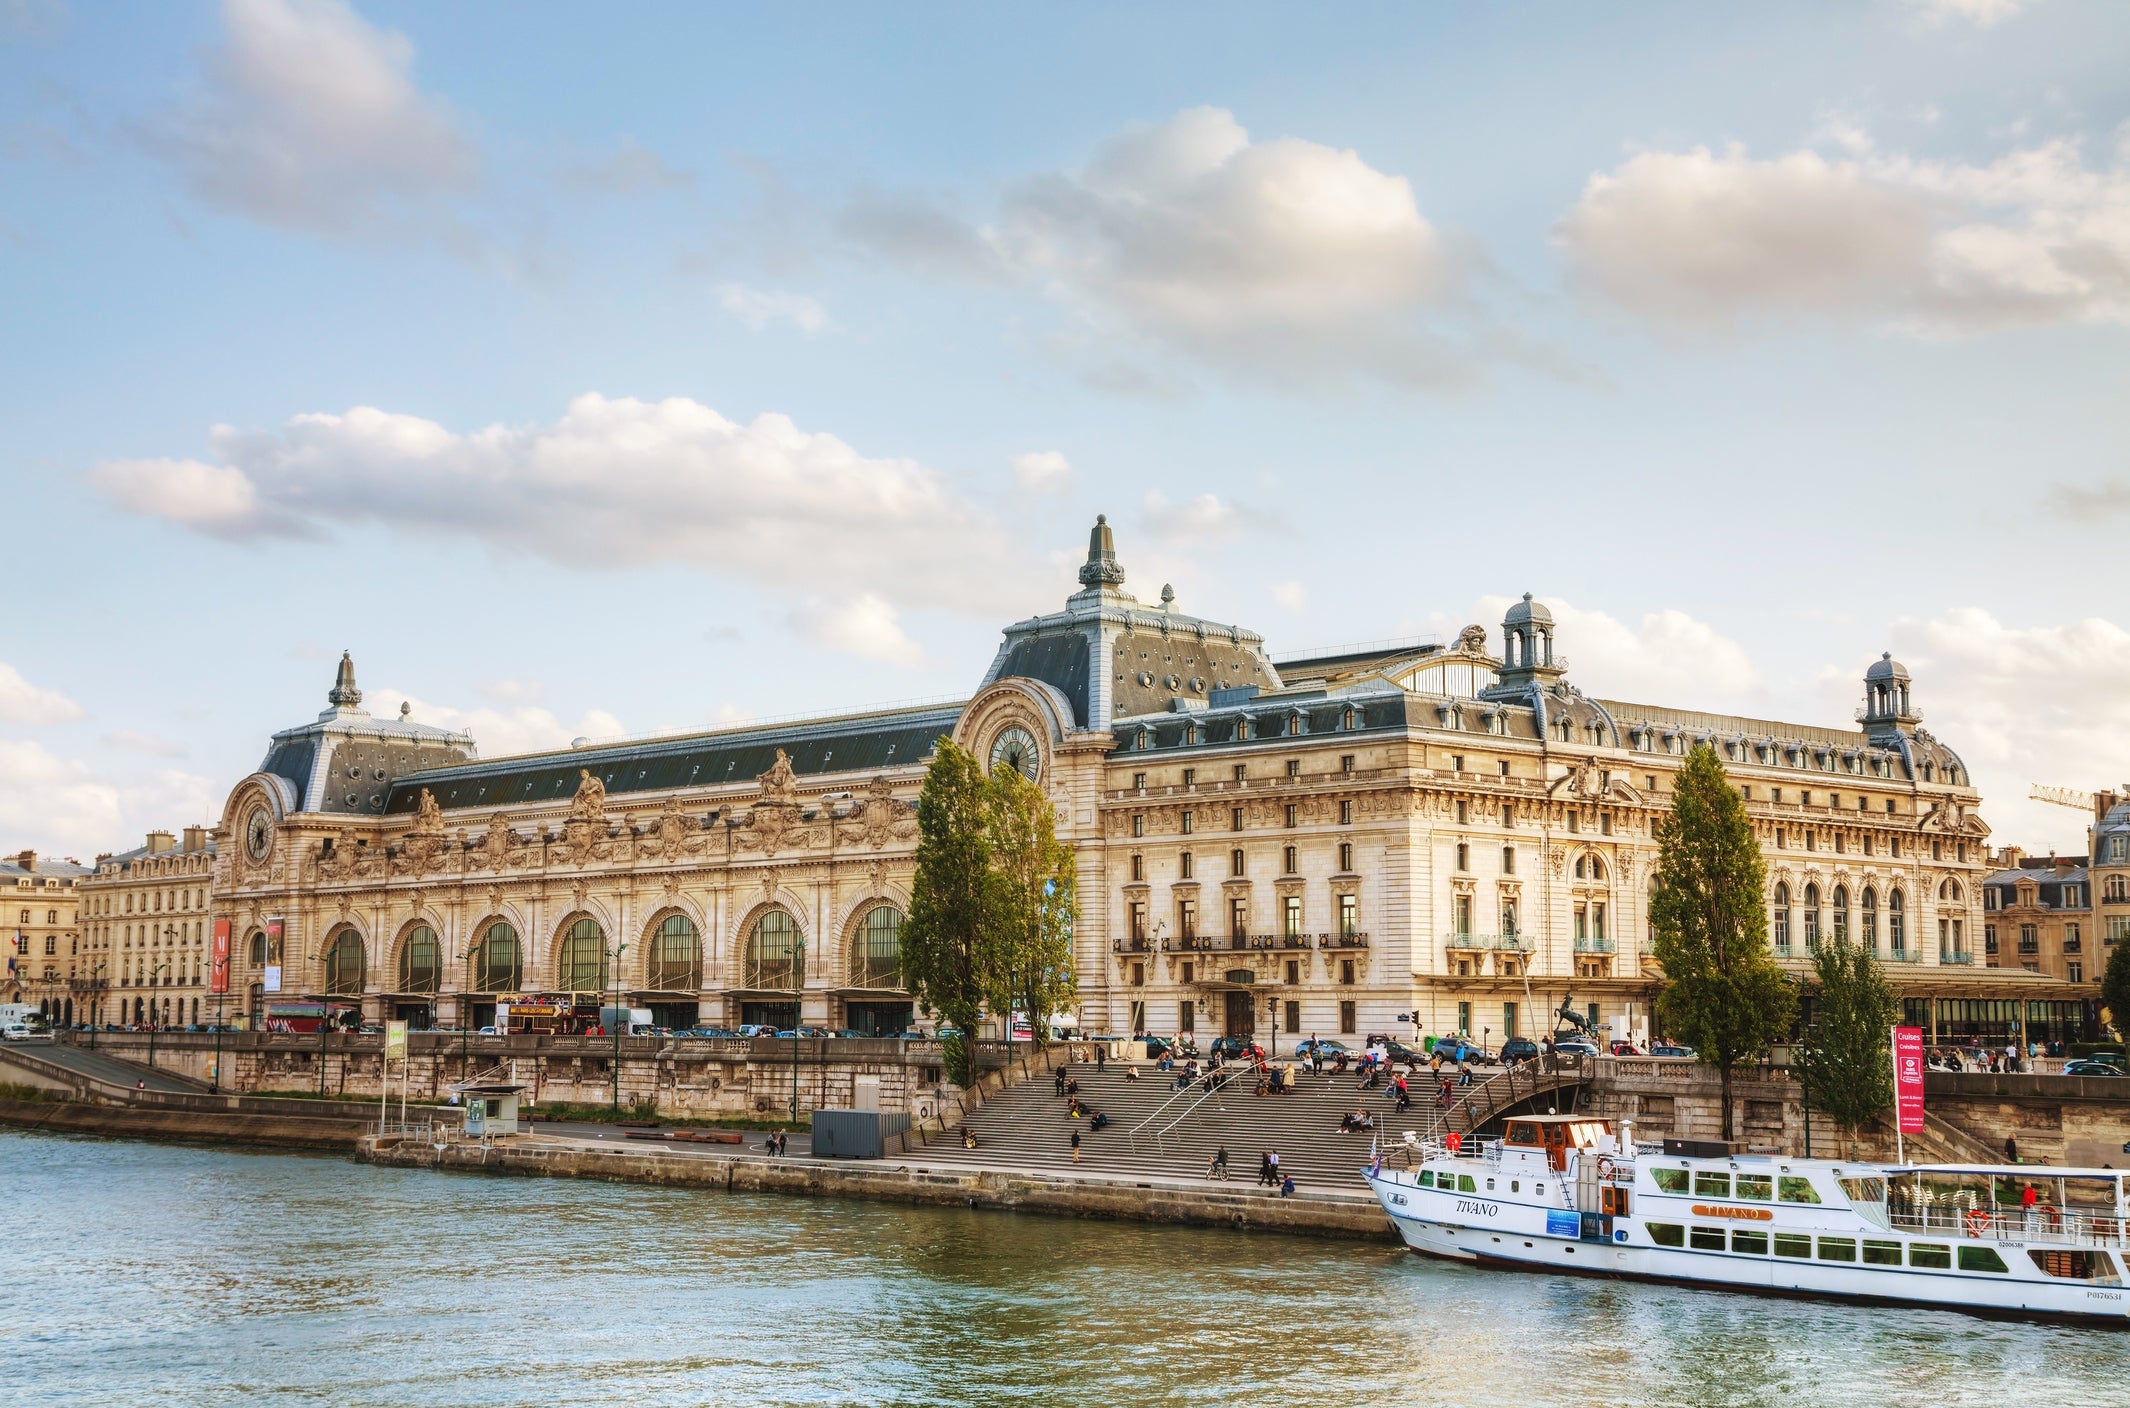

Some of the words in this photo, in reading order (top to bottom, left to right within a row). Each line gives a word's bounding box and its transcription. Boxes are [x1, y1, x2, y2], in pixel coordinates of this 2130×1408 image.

[1898, 1032, 1920, 1041] Cruises
[1456, 1200, 1498, 1217] TIVANO
[1705, 1206, 1759, 1219] TIVANO
